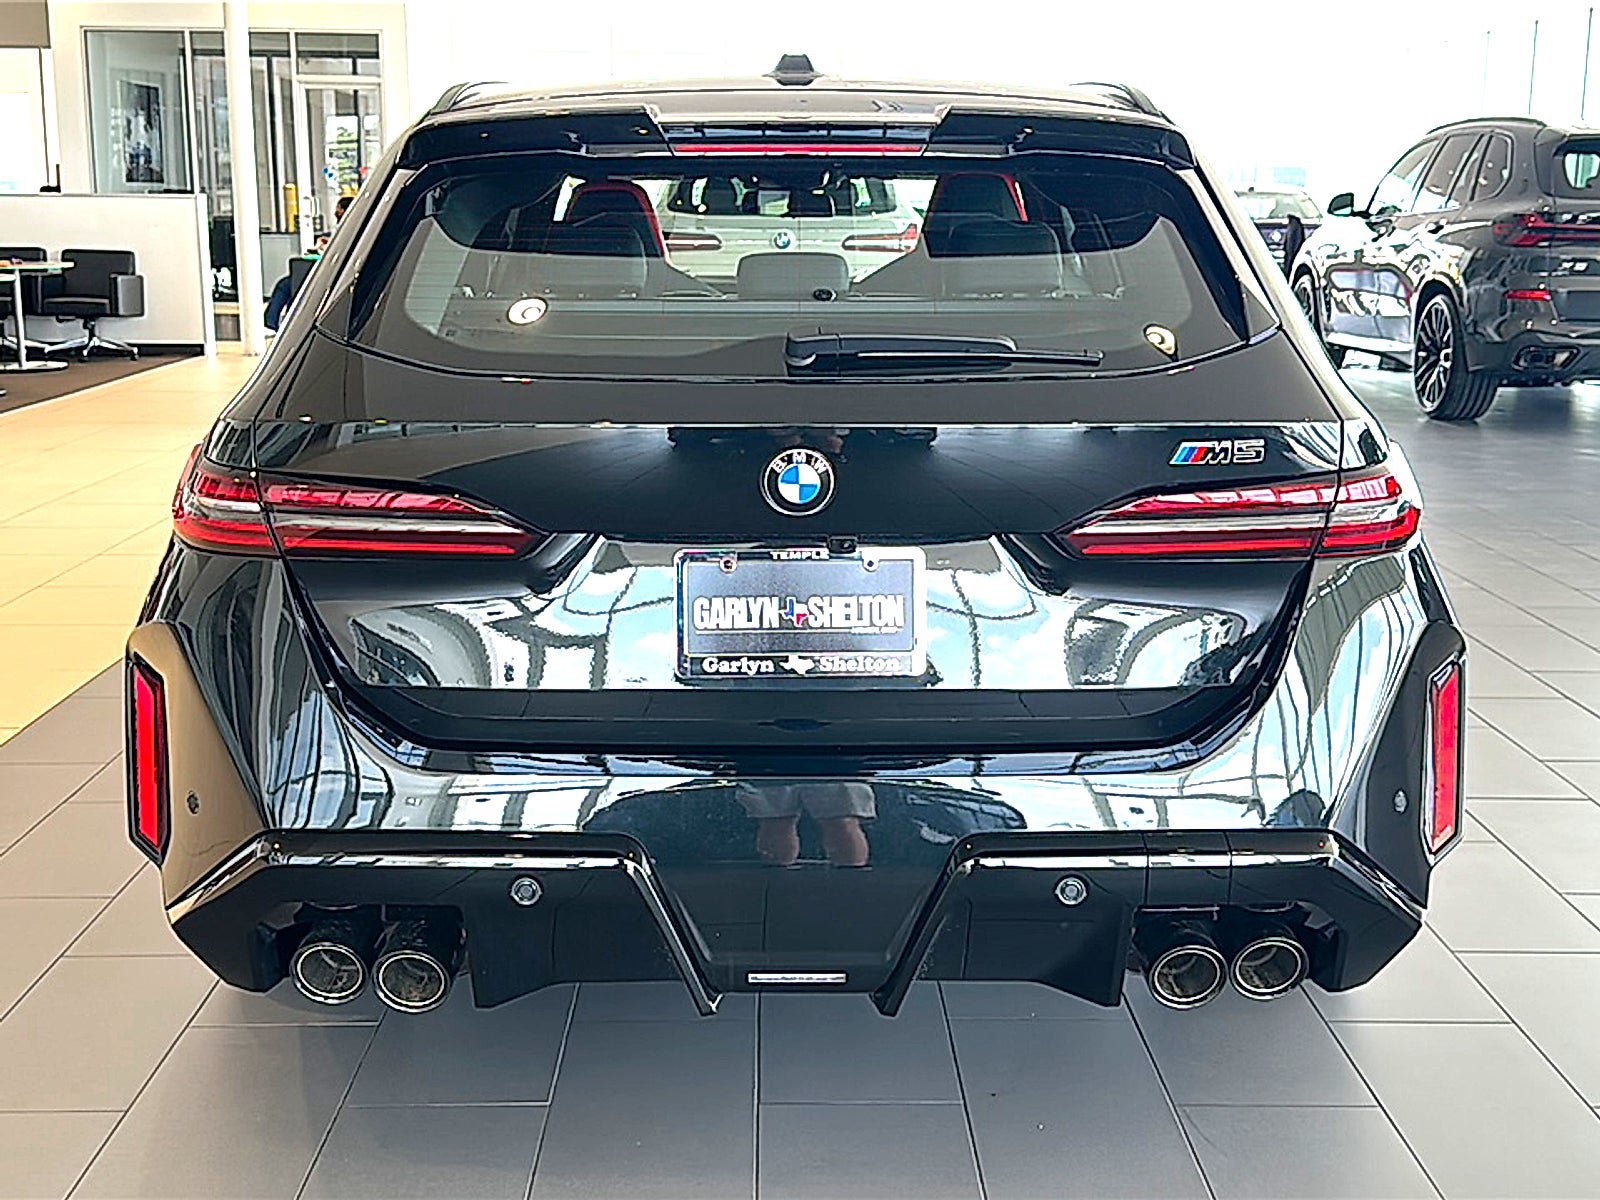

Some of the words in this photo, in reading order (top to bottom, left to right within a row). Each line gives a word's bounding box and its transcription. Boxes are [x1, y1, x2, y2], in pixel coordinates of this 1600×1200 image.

[771, 451, 828, 474] BMW
[1190, 439, 1265, 464] M5
[770, 551, 829, 560] TEMPLE
[693, 596, 780, 630] GARLYN
[807, 595, 904, 628] SHELTON
[702, 657, 776, 676] Garlyn
[818, 656, 900, 674] Shelton
